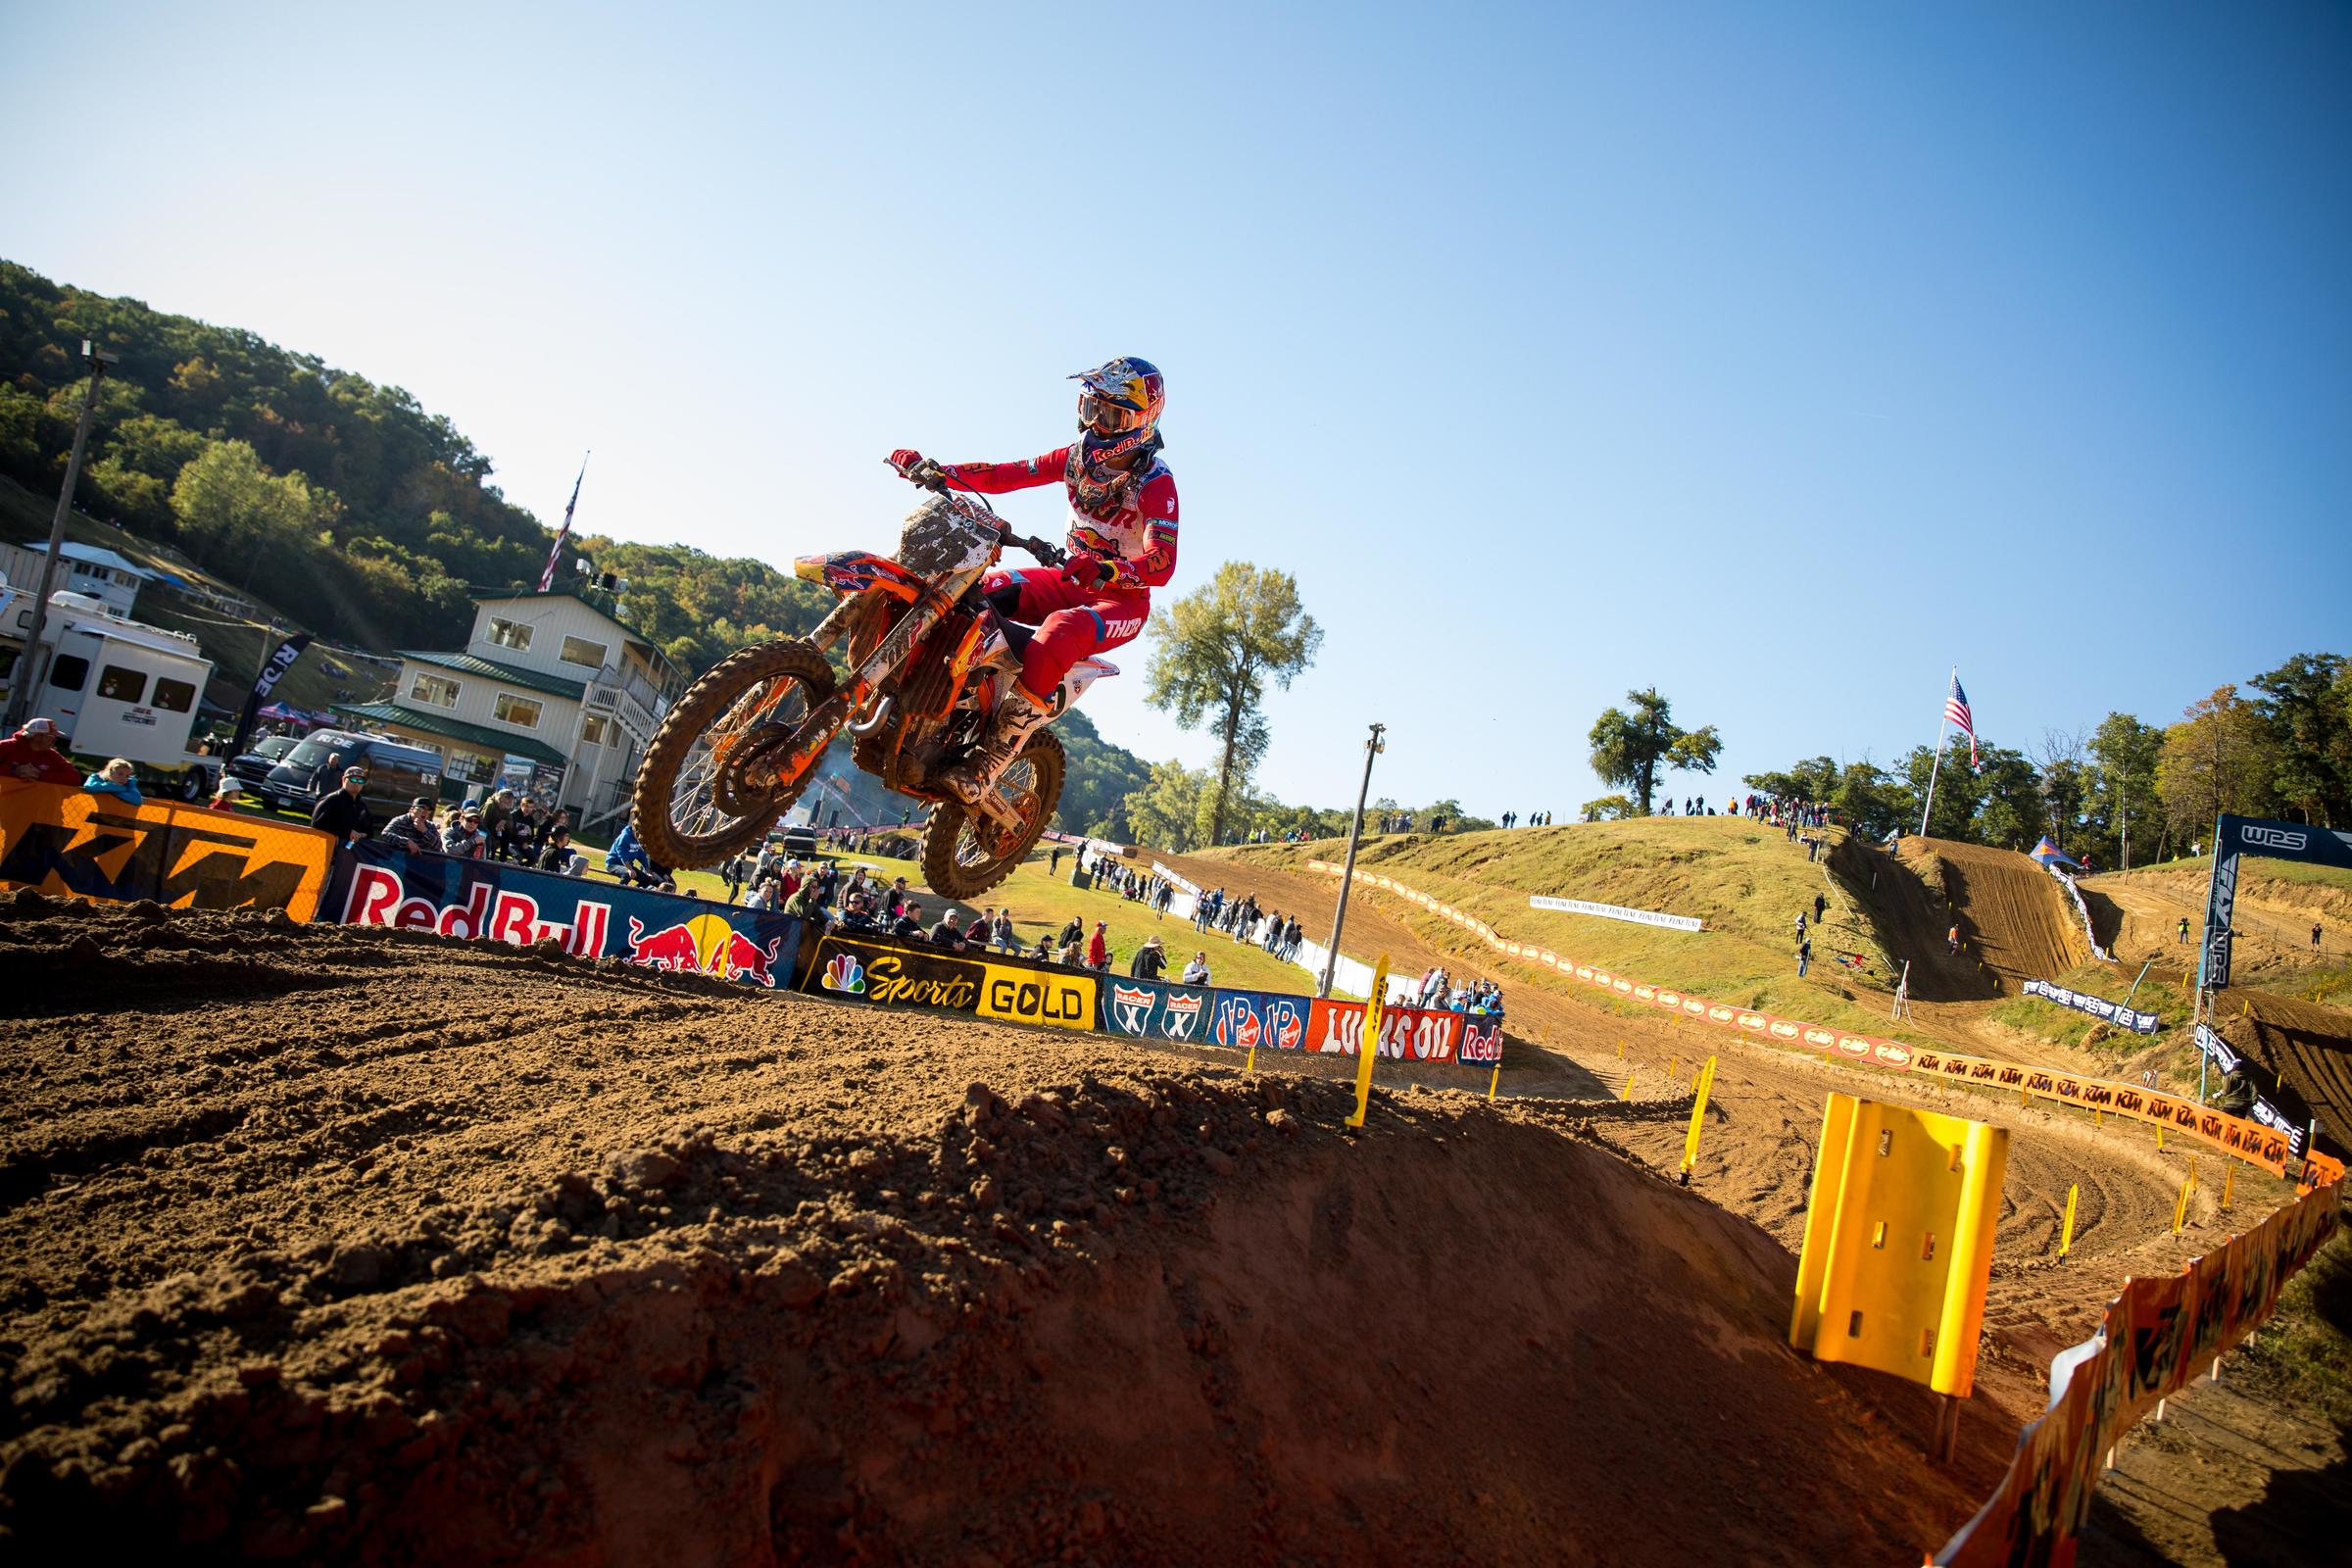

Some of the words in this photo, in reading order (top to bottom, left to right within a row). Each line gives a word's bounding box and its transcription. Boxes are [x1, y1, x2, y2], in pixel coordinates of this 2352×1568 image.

[1093, 442, 1124, 464] Red
[1104, 617, 1142, 639] THOR
[2240, 825, 2308, 851] WPS
[0, 811, 309, 912] KTM
[340, 862, 493, 941] Red
[489, 890, 612, 958] Bull
[866, 956, 975, 1009] Sports
[991, 979, 1083, 1020] GOLD
[1117, 992, 1152, 1005] RACER
[1123, 1004, 1142, 1033] X
[1170, 1001, 1199, 1010] RACER
[1169, 1012, 1187, 1037] X
[1413, 1015, 1452, 1059] OIL
[1461, 1024, 1497, 1061] Red
[2115, 1090, 2142, 1112] KTM
